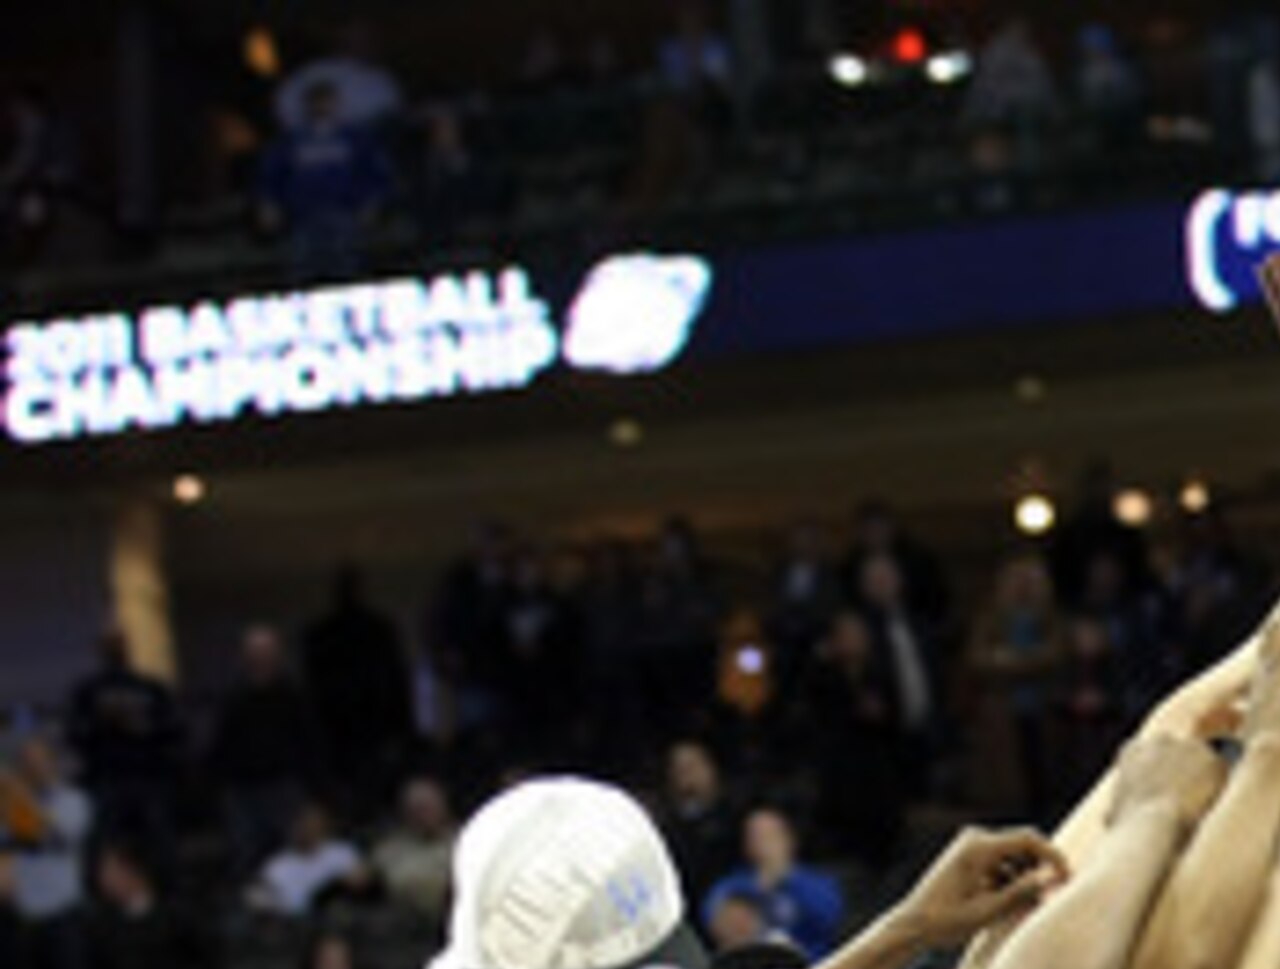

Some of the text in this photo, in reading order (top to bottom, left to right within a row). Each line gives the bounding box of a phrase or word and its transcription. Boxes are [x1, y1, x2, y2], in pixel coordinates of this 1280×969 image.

[4, 322, 556, 440] CHAMPIONSHIP
[5, 315, 131, 380] 2011
[140, 268, 545, 366] BASKETBALL
